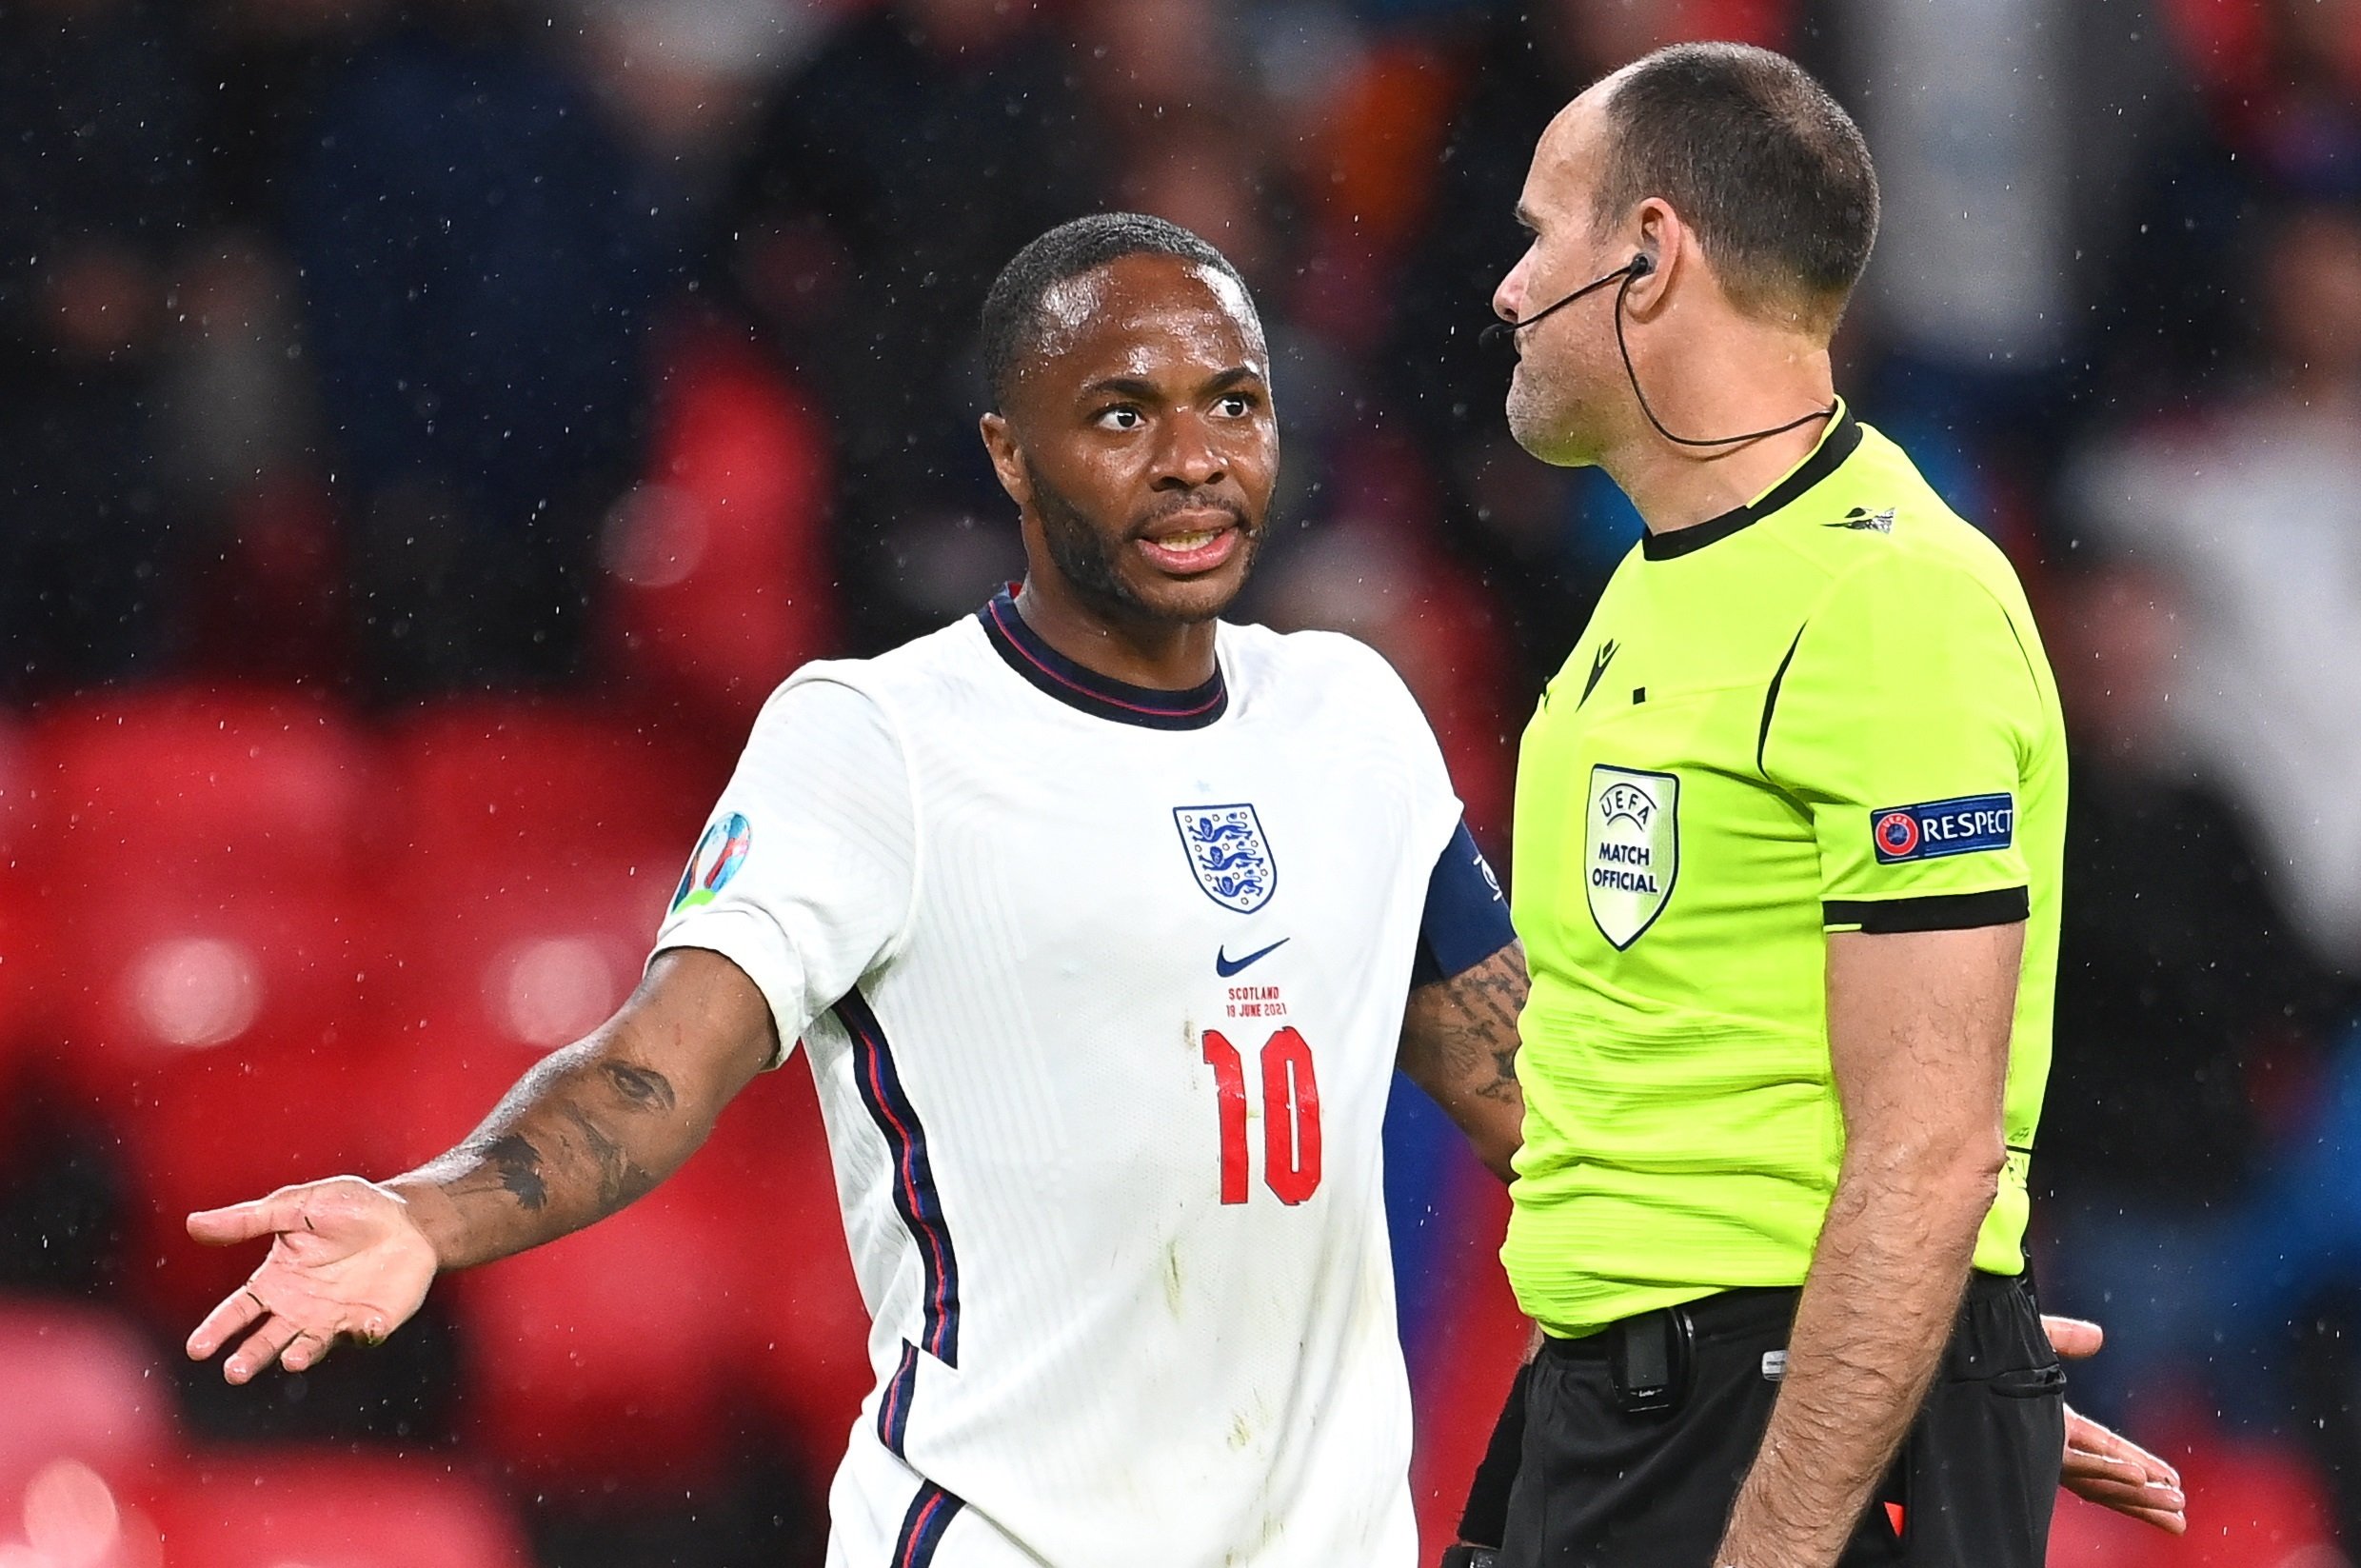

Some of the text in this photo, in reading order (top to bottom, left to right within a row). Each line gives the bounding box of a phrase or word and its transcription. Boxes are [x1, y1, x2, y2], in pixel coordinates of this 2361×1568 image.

[1600, 789, 1651, 825] UEFA
[1921, 809, 2014, 843] RESPECT
[1598, 842, 1650, 866] MATCH
[1592, 867, 1658, 893] OFFICIAL
[1228, 986, 1280, 1001] SCOTLAND
[1239, 1003, 1261, 1018] JUNE
[1264, 1002, 1287, 1016] 2021
[1201, 1025, 1322, 1206] 10
